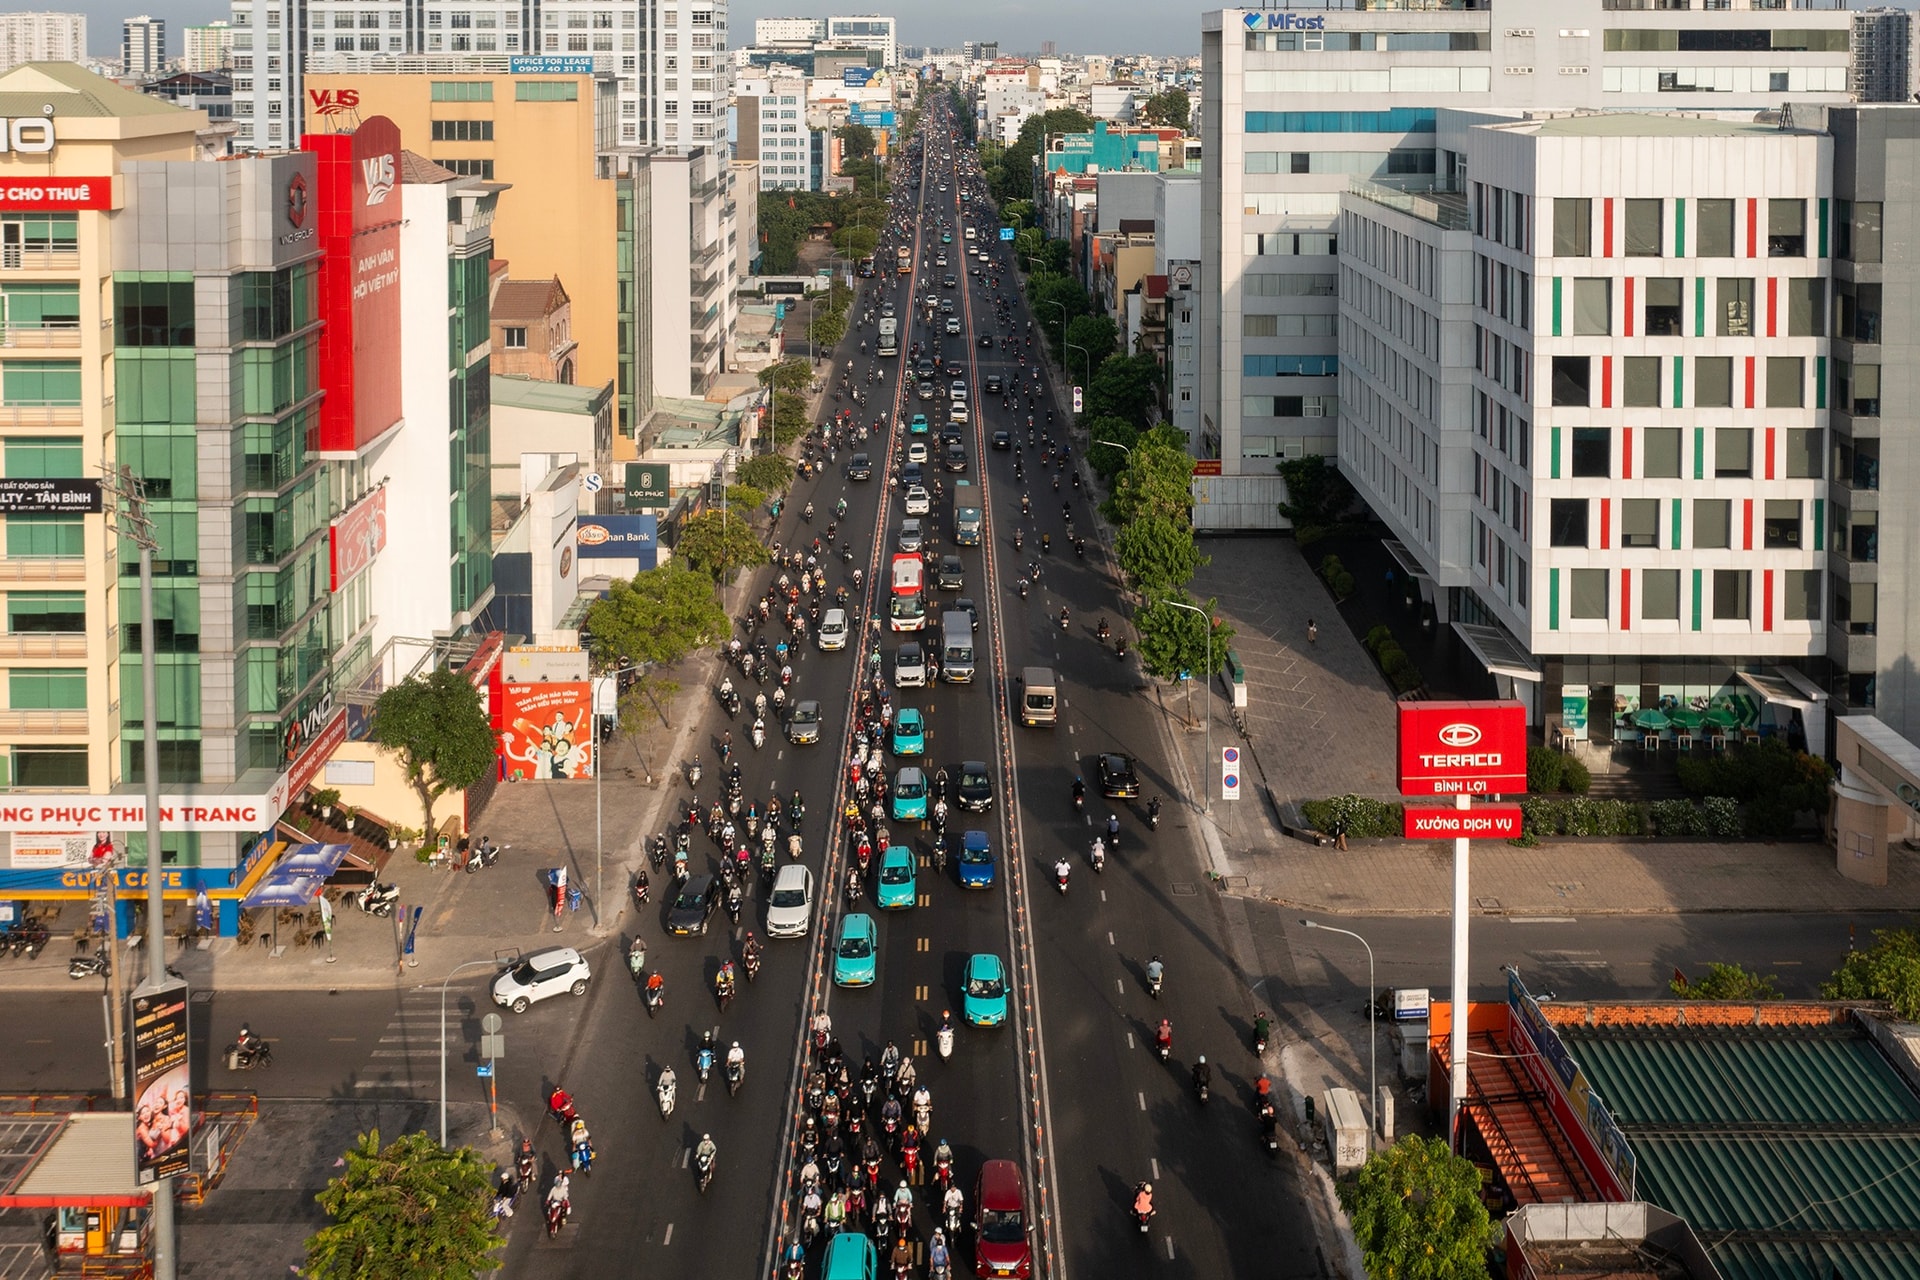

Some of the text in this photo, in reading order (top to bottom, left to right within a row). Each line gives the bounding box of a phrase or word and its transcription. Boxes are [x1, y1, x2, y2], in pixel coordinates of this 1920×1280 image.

[1268, 14, 1324, 29] MFast
[309, 89, 359, 107] VUS
[362, 153, 395, 194] VUS
[7, 187, 44, 201] CHO
[46, 184, 91, 201] THUÊ
[295, 229, 314, 241] GROUP
[358, 256, 376, 273] ANH
[353, 282, 368, 299] HỘI
[369, 274, 386, 294] VIỆT
[0, 493, 24, 503] LTY
[35, 490, 60, 503] TÂN
[62, 490, 91, 503] BÌNH
[626, 532, 650, 541] Bank
[1420, 753, 1501, 767] TERACO
[1434, 779, 1487, 793] BÌNH LỢI
[0, 808, 257, 827] NG PHỤC THIN TRANG
[1415, 816, 1512, 831] XƯỞNG DỊCH VỤ
[245, 838, 267, 872] GUTA
